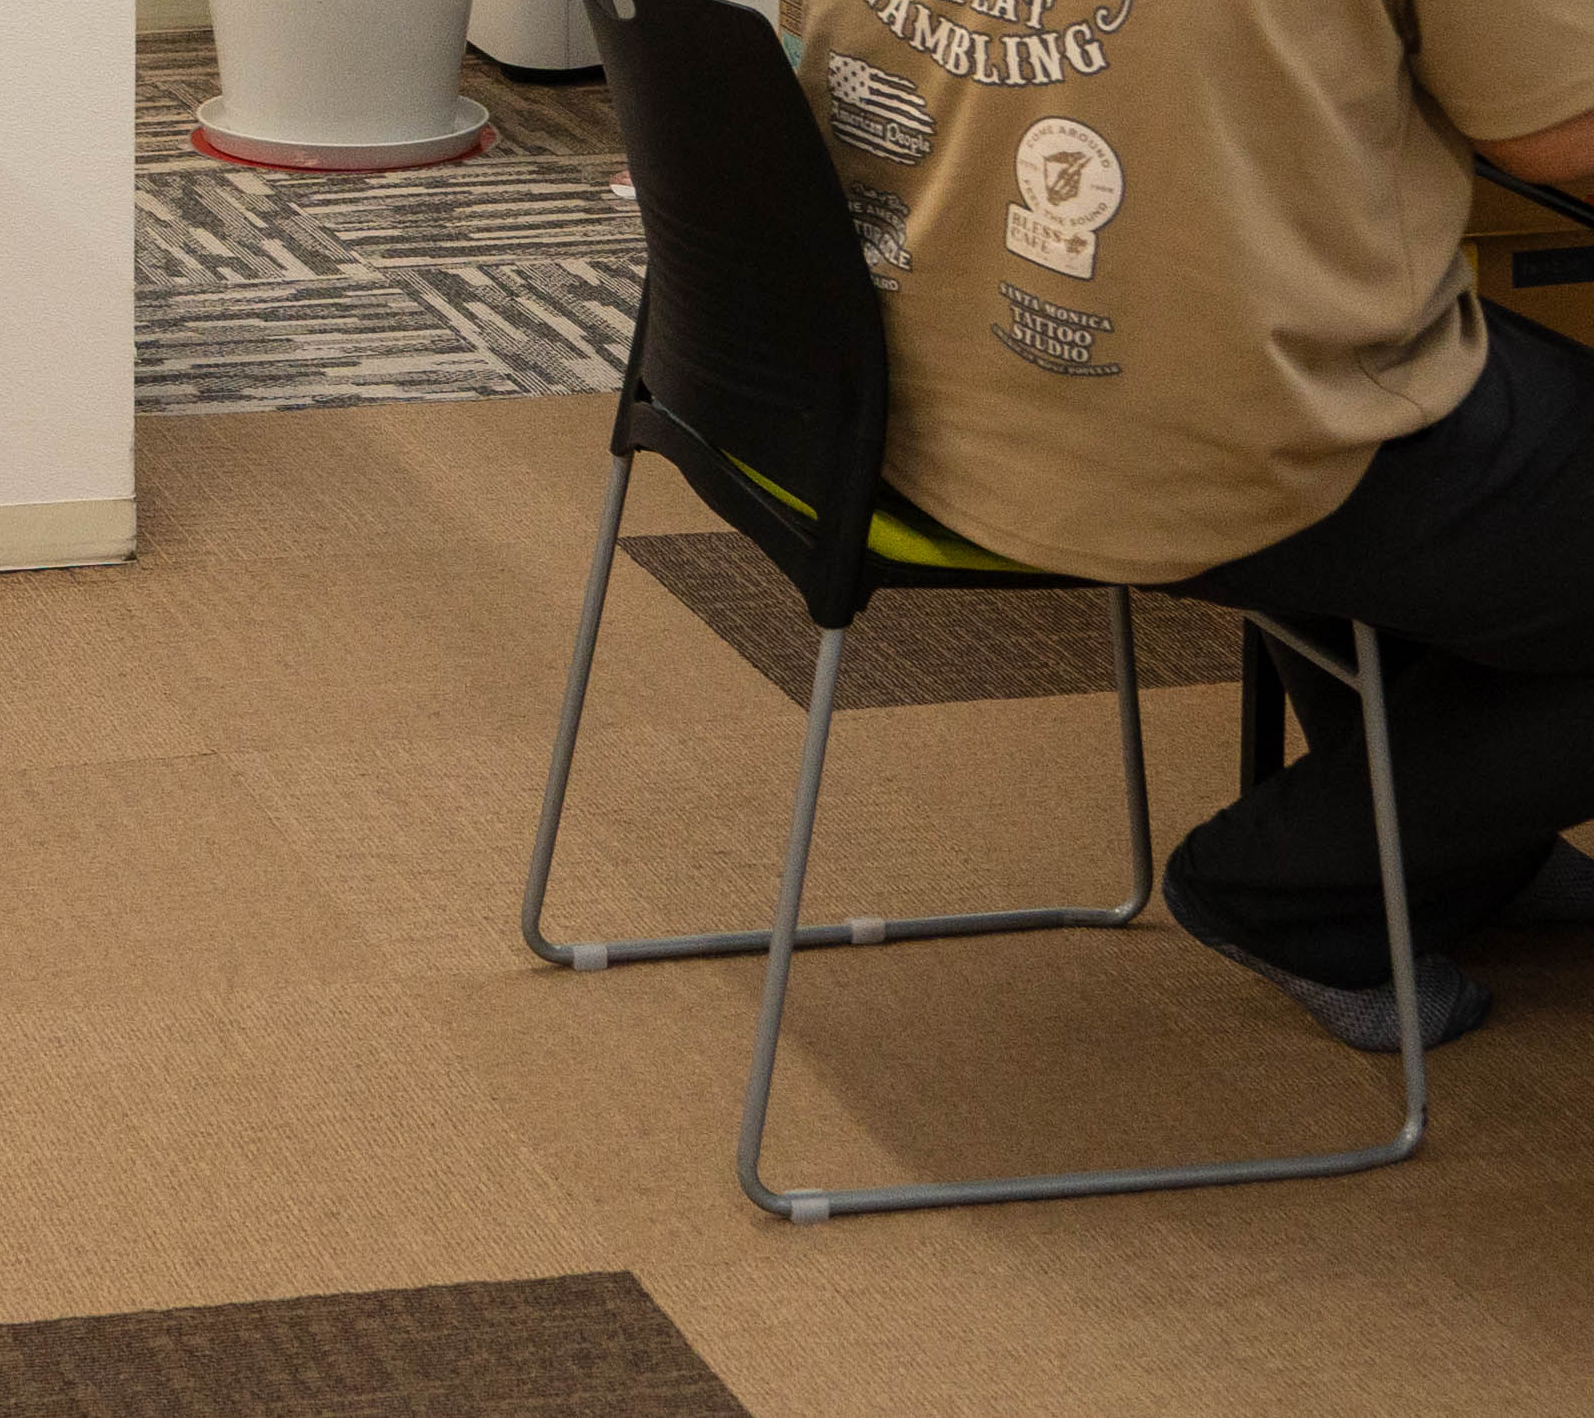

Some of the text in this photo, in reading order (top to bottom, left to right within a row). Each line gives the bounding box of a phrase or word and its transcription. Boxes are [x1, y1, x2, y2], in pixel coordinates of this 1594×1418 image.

[1057, 125, 1112, 170] AROUND
[1011, 211, 1062, 244] BLESS
[1069, 201, 1109, 228] SOUND
[1011, 305, 1092, 347] TATTOO
[1044, 303, 1112, 331] MONICA
[1011, 323, 1090, 363] STUDIO
